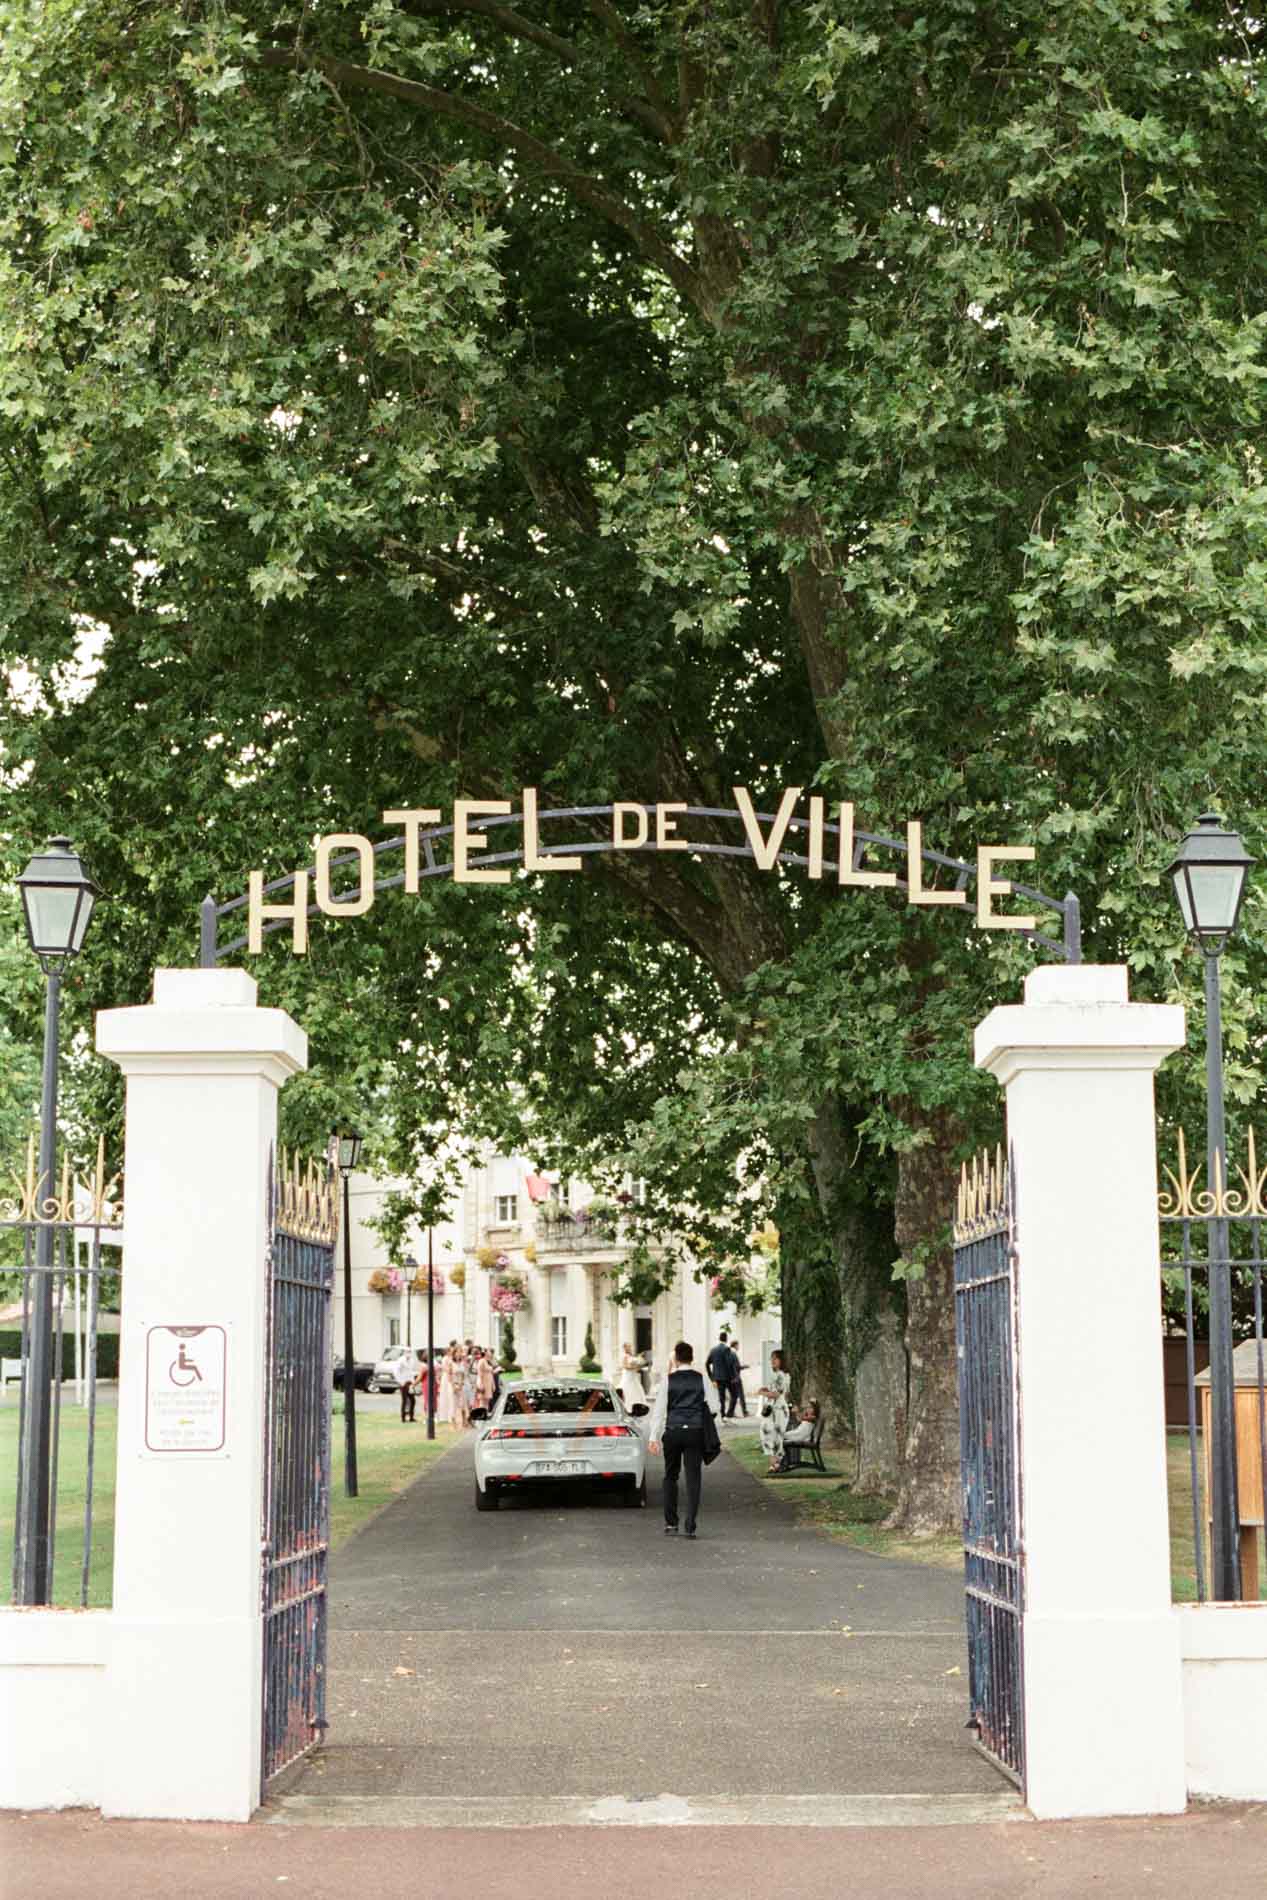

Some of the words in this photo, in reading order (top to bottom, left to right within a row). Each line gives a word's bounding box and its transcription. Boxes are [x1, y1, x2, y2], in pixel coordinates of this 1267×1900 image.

[248, 787, 582, 953] HOTEL
[612, 802, 688, 849] DE
[733, 786, 1037, 929] VILLE
